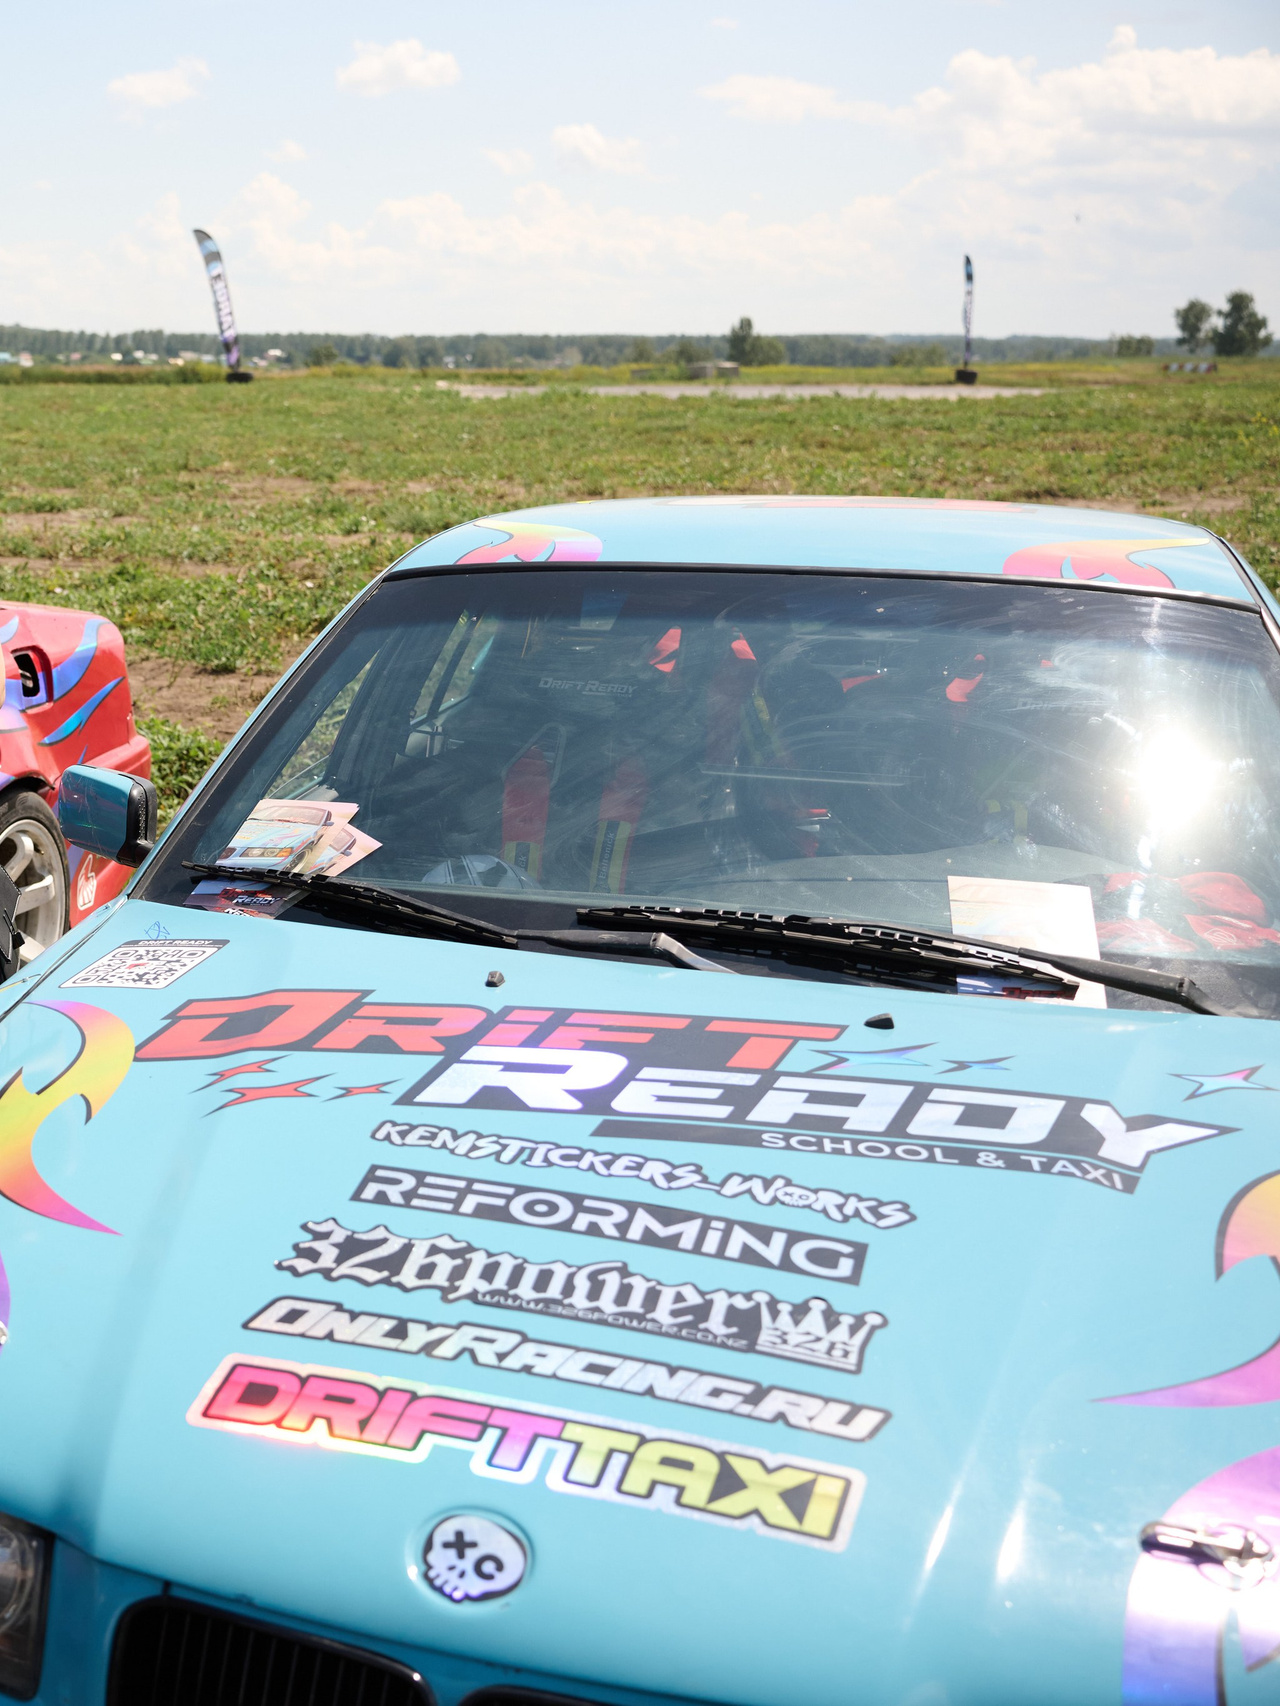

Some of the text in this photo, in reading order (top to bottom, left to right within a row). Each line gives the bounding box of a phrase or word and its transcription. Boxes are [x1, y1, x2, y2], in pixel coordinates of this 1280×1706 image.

[232, 895, 280, 904] READY
[134, 989, 842, 1069] DRIFT
[412, 1045, 1222, 1169] READY
[760, 1132, 1124, 1190] SCHOOL & TAXI
[247, 1300, 886, 1442] ONLYRACING.RU
